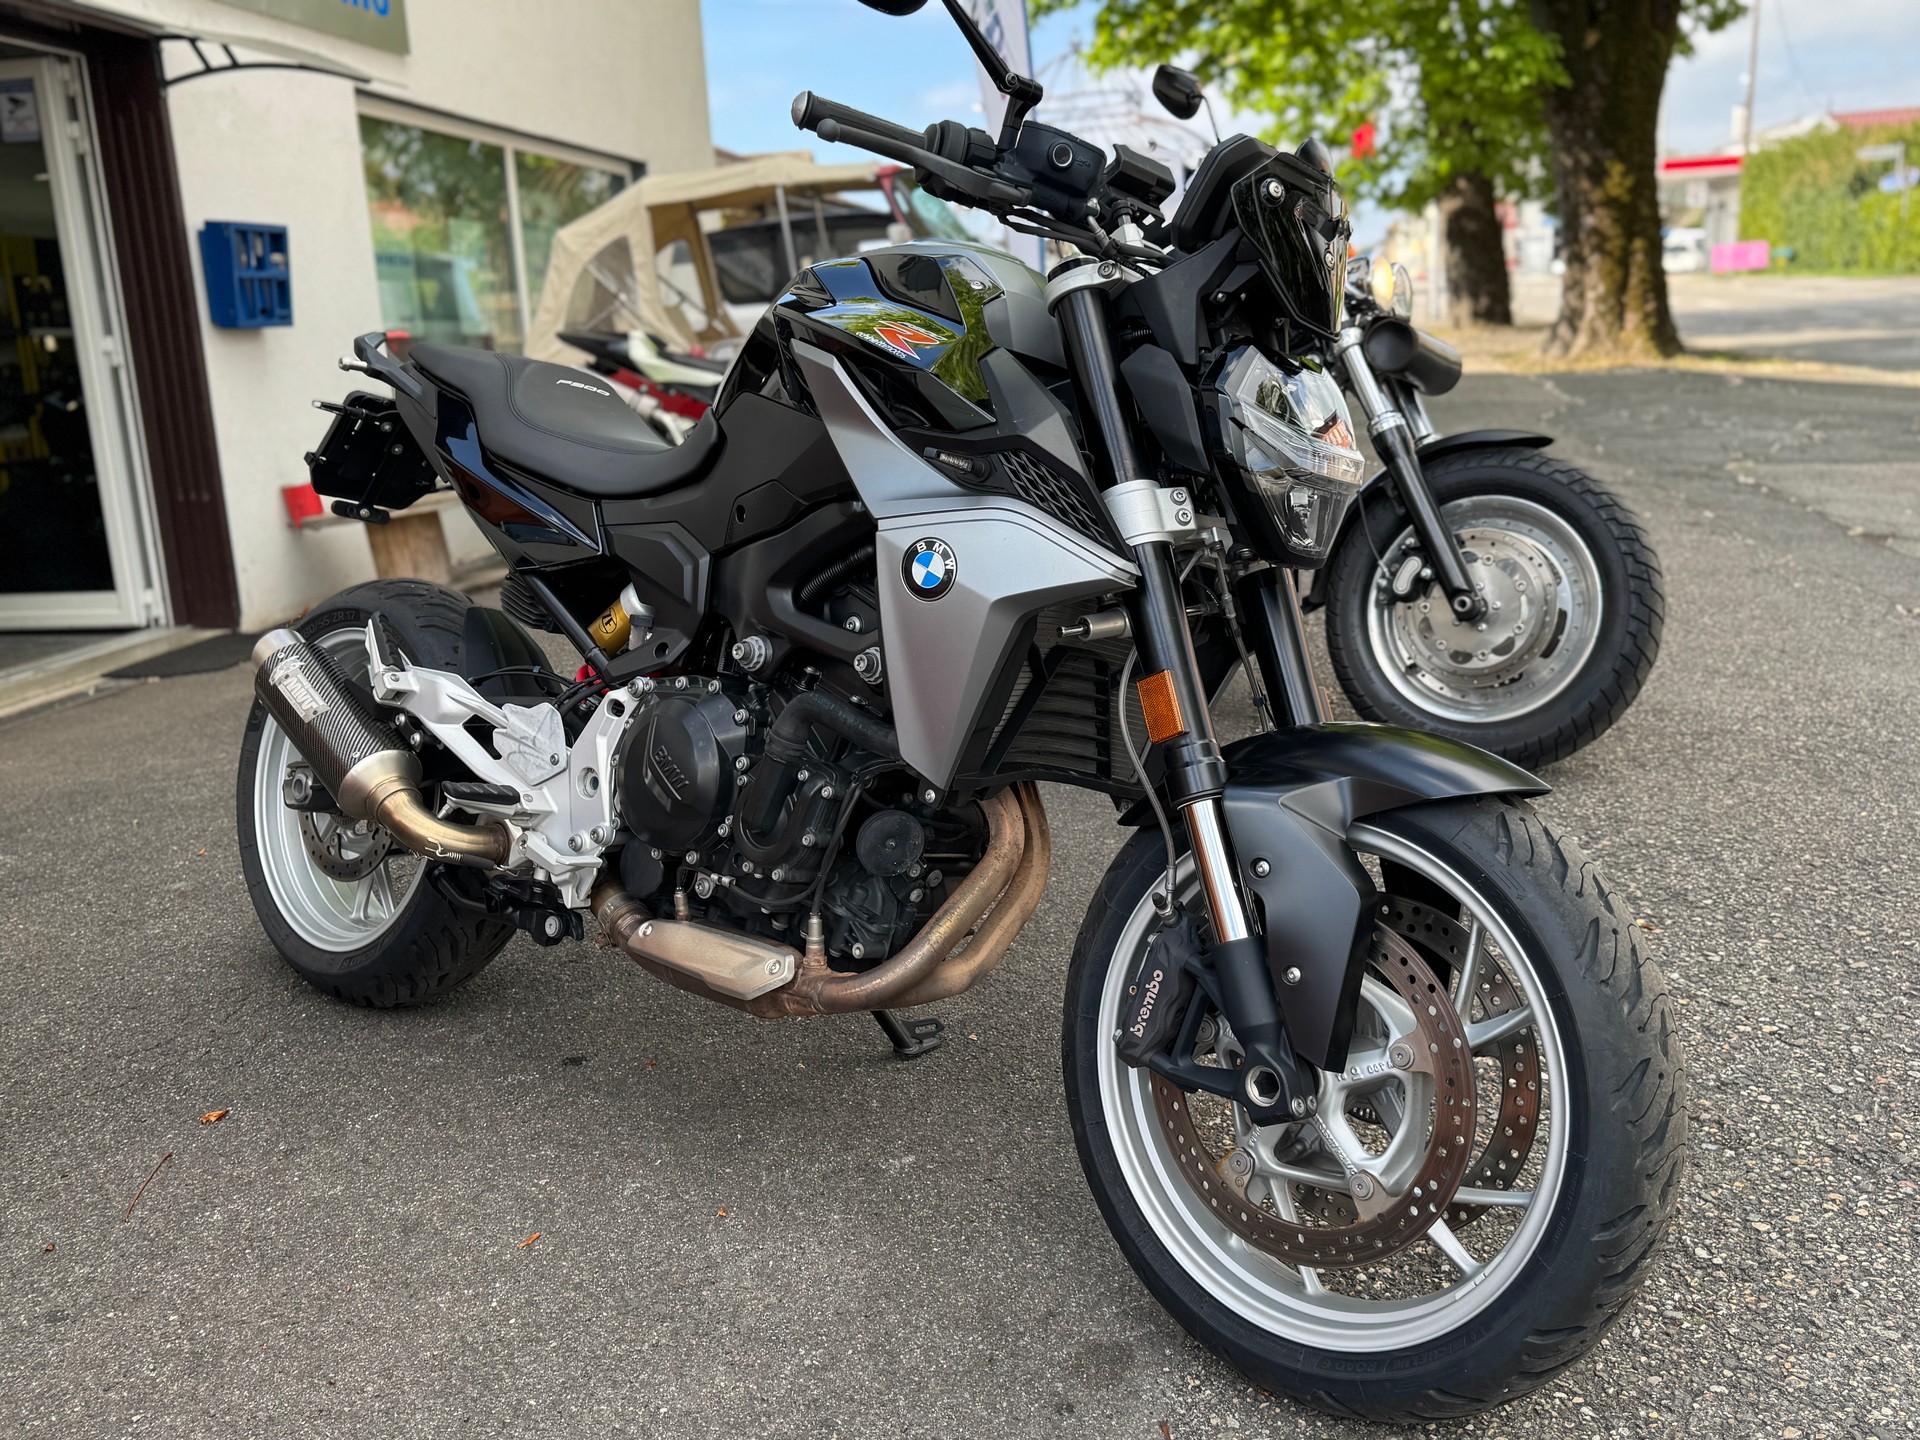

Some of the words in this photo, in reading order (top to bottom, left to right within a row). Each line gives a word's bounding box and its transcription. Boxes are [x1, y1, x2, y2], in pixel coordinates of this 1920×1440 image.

[556, 379, 610, 397] F900
[916, 541, 955, 570] BMW
[654, 745, 690, 791] BMW
[1129, 969, 1164, 1038] brembo
